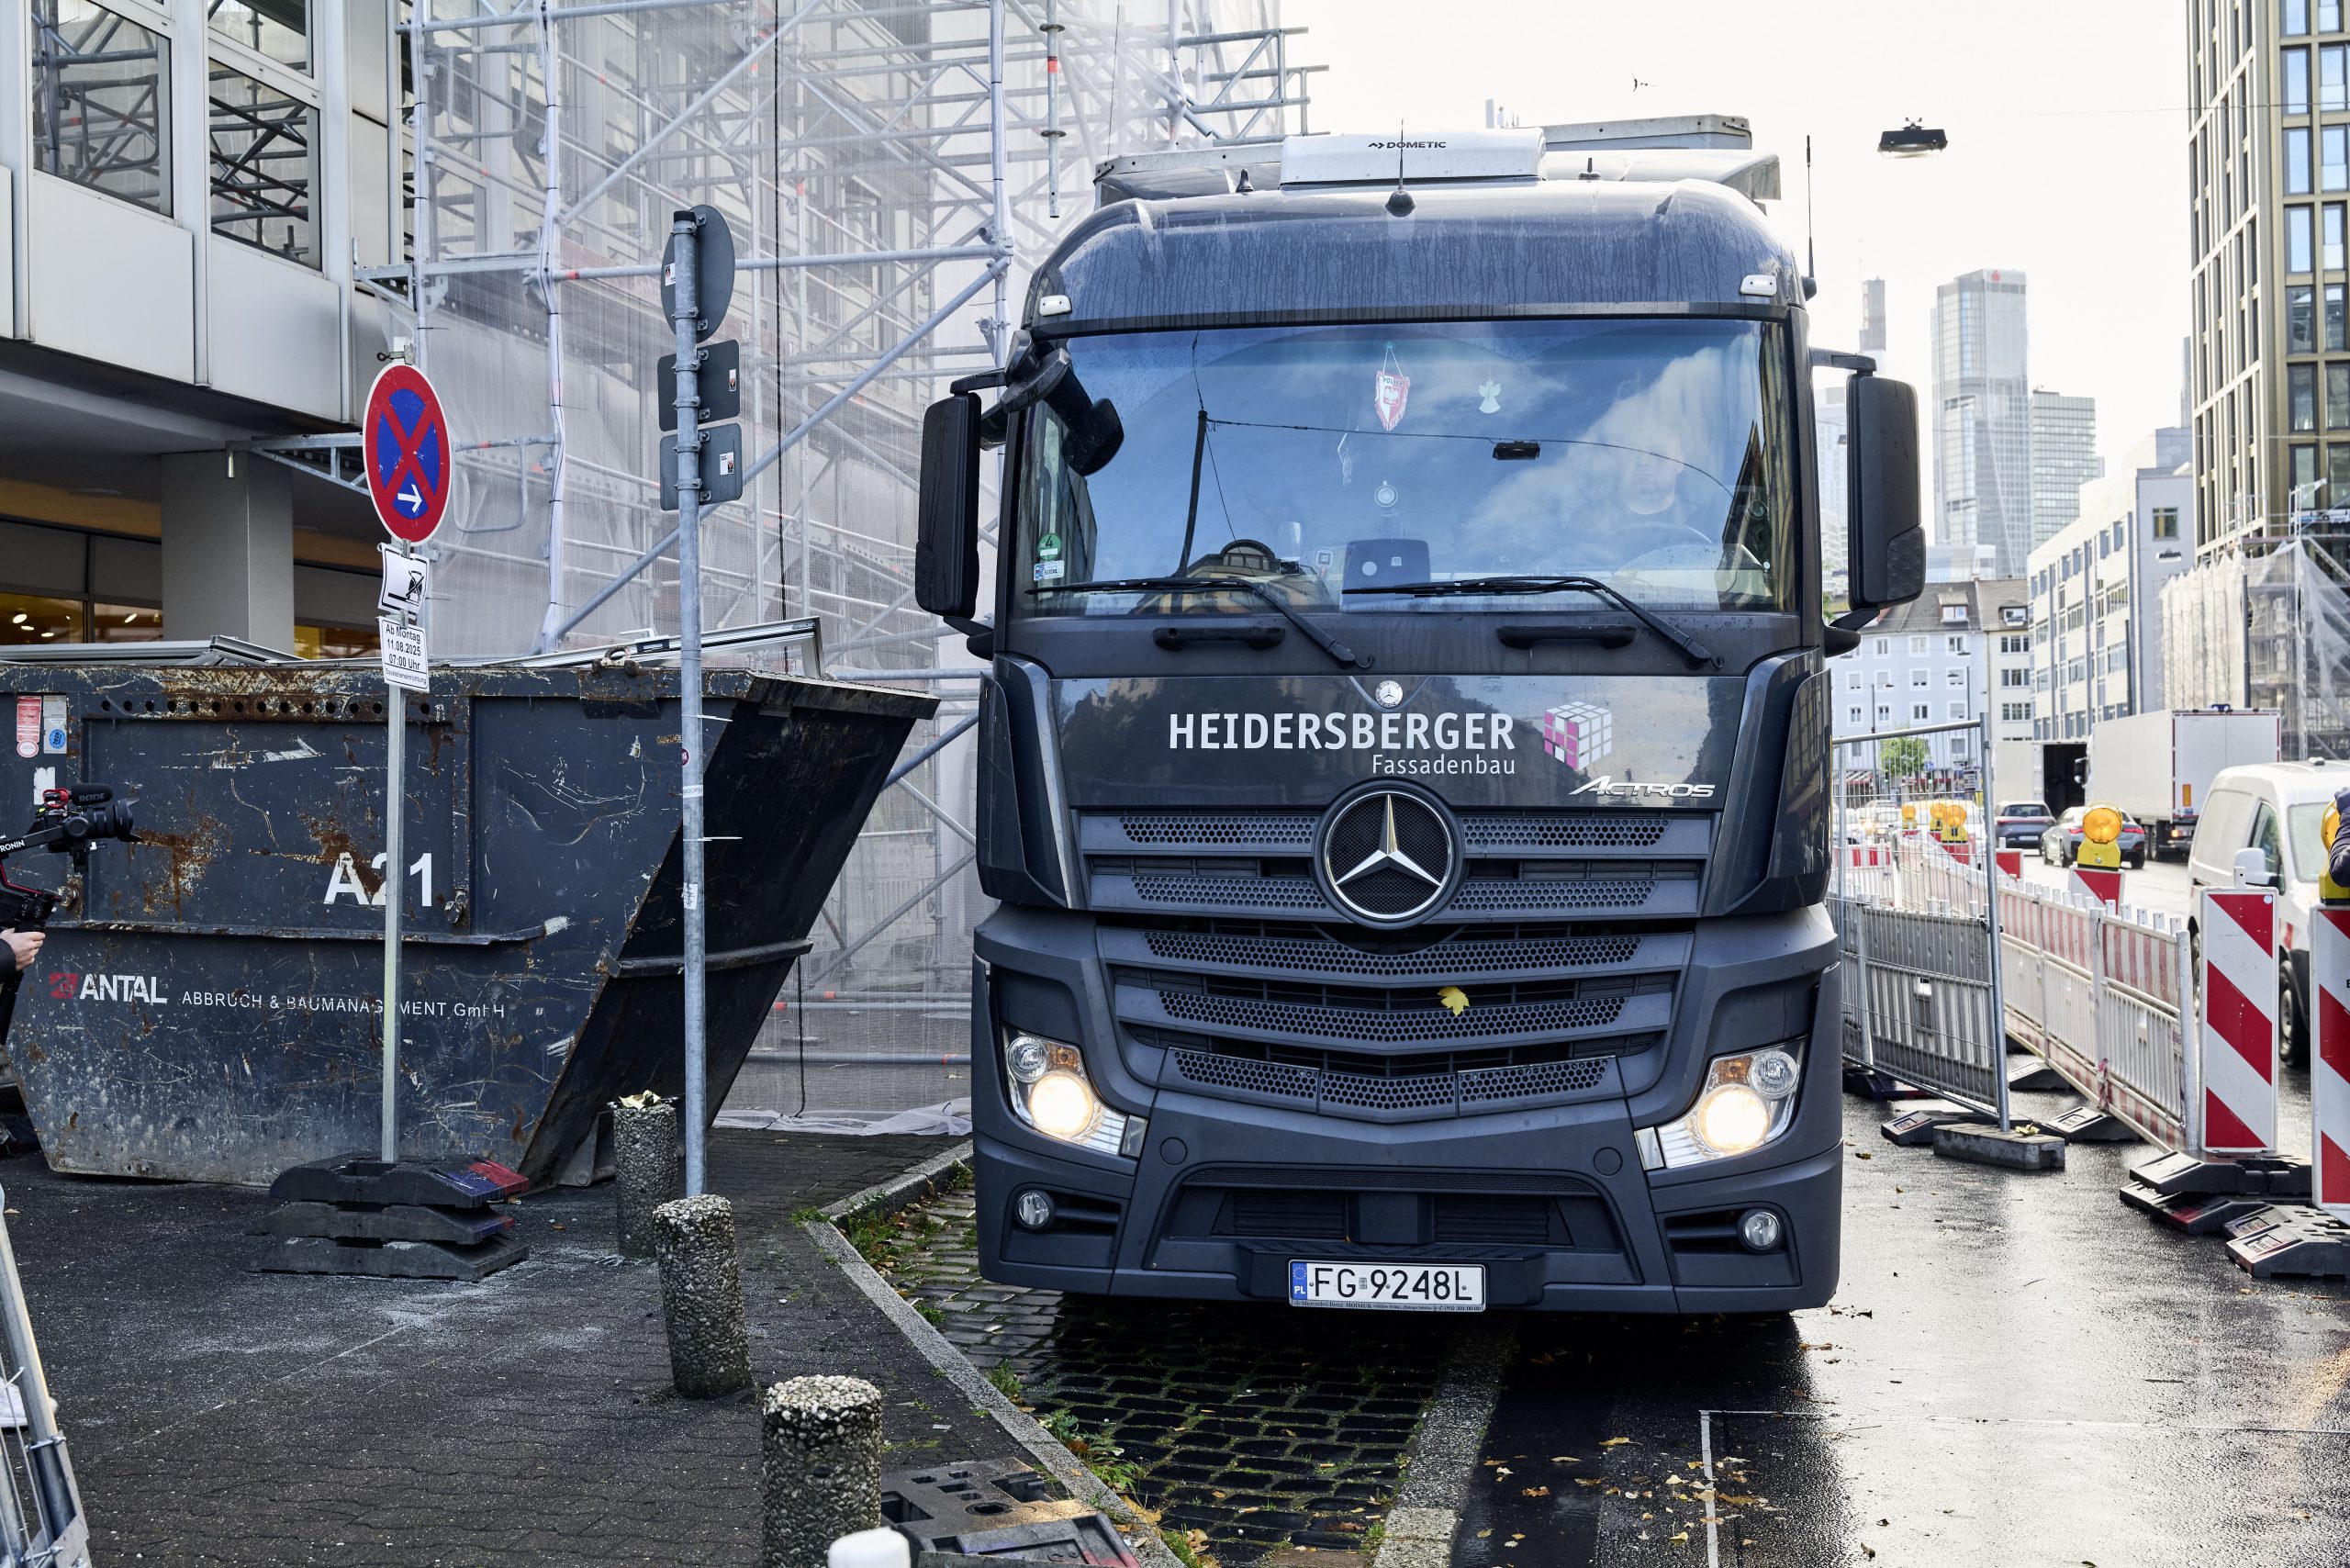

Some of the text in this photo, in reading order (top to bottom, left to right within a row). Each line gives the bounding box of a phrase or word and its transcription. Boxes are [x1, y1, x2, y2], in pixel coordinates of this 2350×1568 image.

[1045, 535, 1053, 547] 4
[386, 623, 421, 644] Ab Montag
[386, 638, 421, 656] 11.08.2025
[388, 653, 420, 671] 07:00 Uhr
[1169, 711, 1516, 750] HEIDERSBERGER
[1372, 753, 1516, 775] Fassadenbau
[0, 839, 26, 853] RONIN
[79, 973, 168, 1004] ANTAL
[182, 991, 263, 1009] ABBRUCH
[269, 995, 280, 1010] &
[286, 996, 448, 1017] BAUMANAGMENT
[1293, 1285, 1306, 1295] PL
[1315, 1267, 1472, 1302] FG 9248L
[1301, 1301, 1344, 1309] Mercedes-Benz
